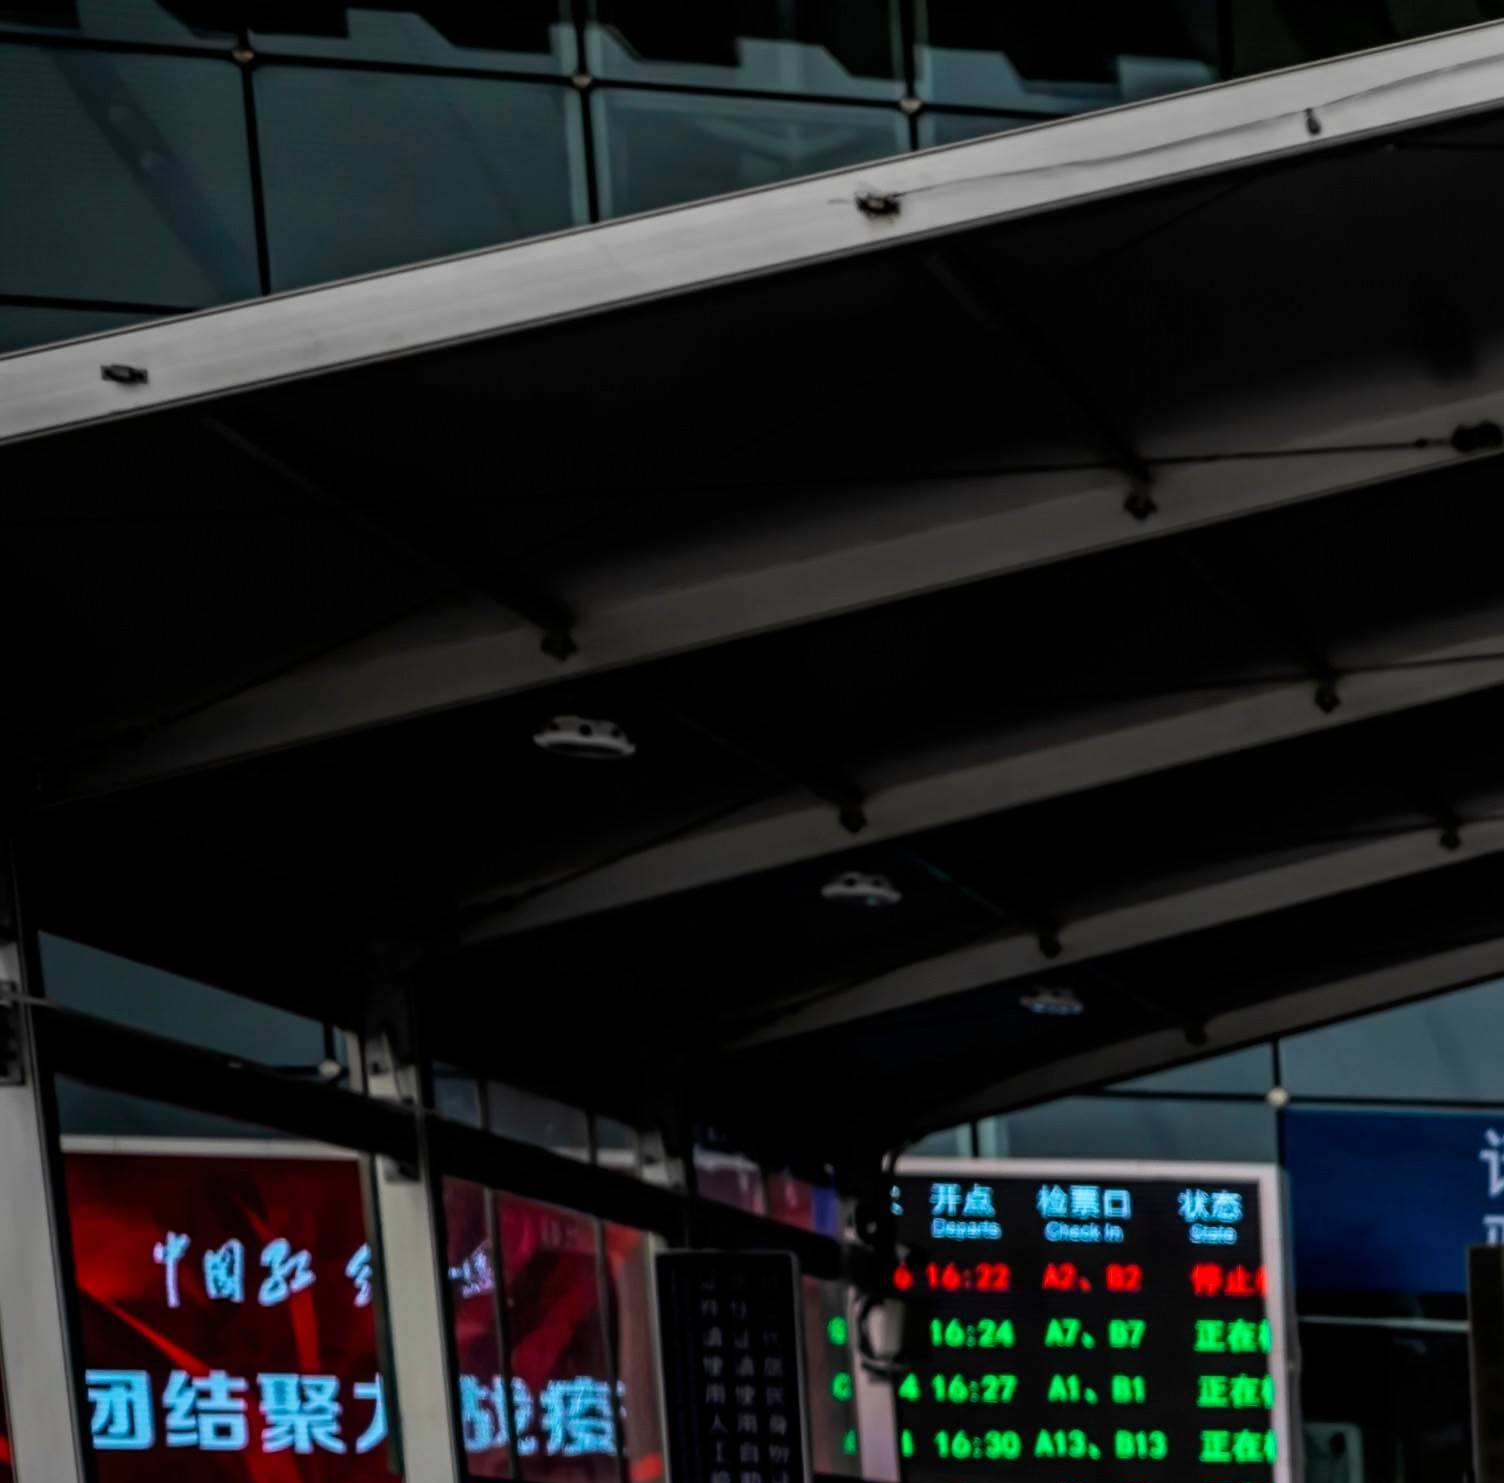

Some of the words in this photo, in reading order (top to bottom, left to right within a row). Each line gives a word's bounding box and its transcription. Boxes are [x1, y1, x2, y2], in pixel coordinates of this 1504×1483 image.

[1036, 1184, 1133, 1222] 检票口
[1178, 1188, 1244, 1222] 状态
